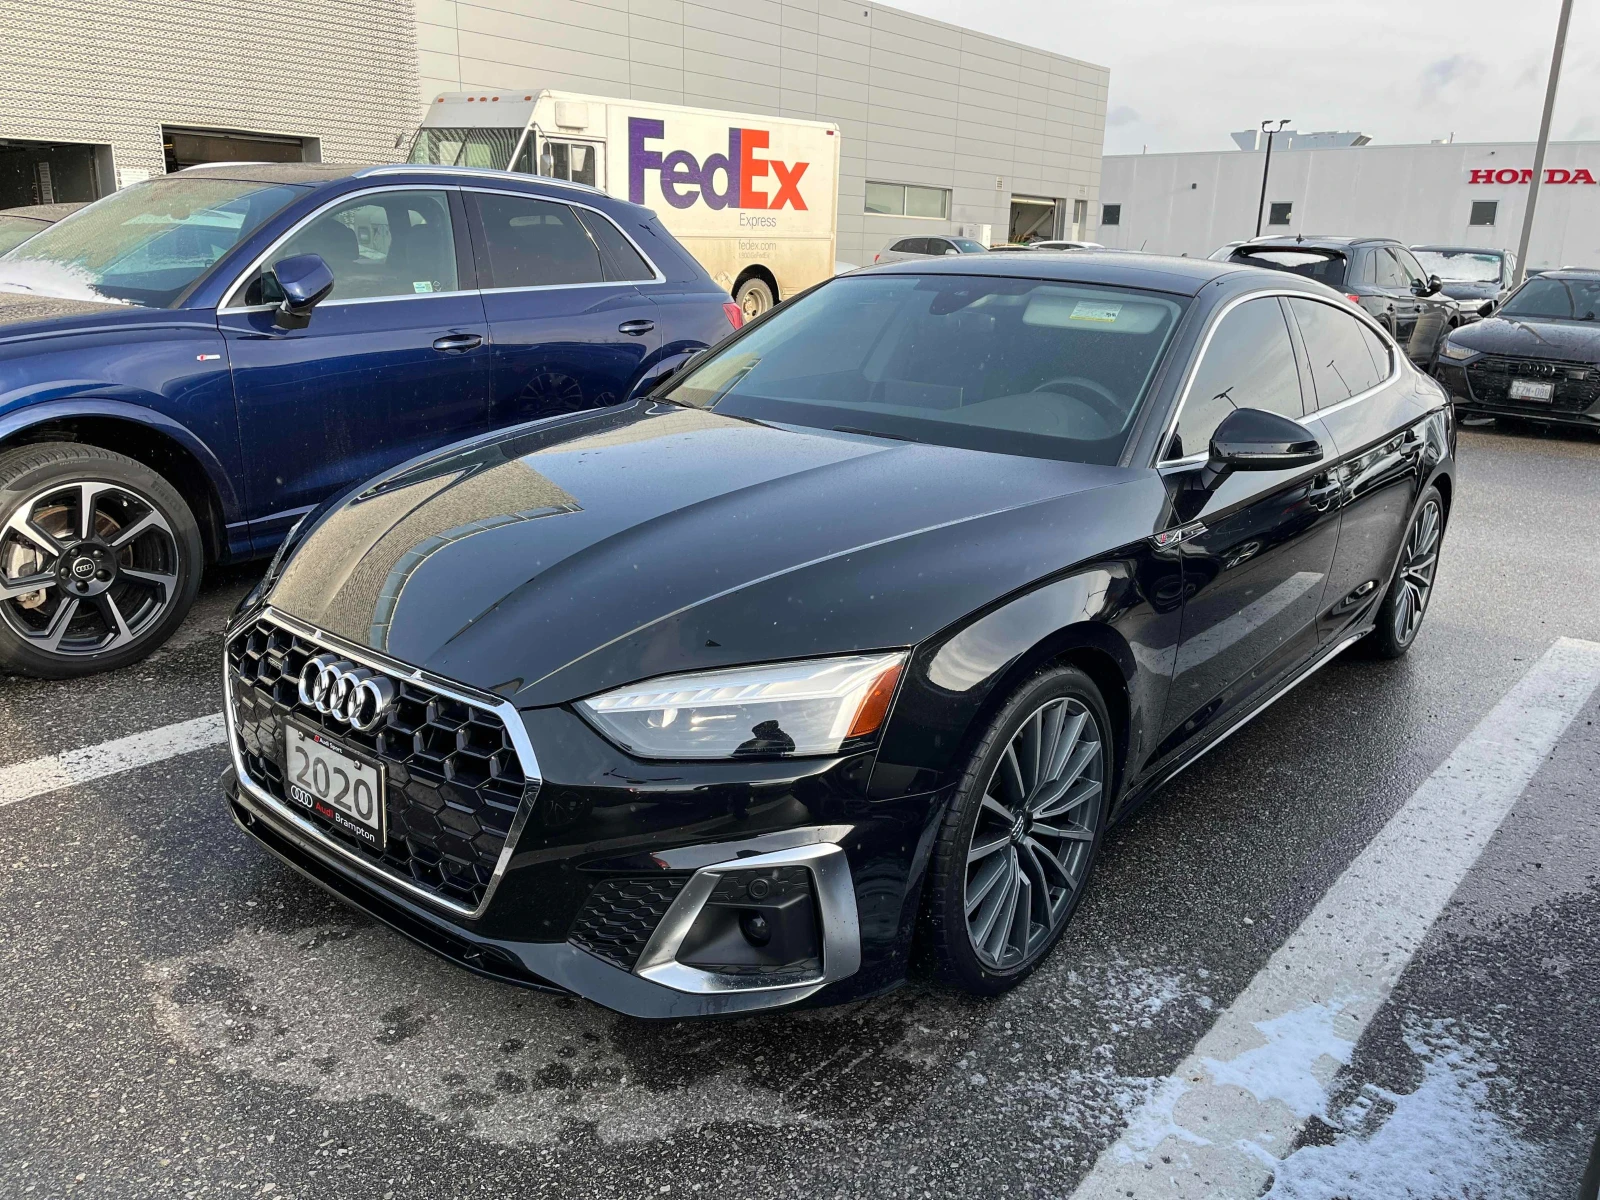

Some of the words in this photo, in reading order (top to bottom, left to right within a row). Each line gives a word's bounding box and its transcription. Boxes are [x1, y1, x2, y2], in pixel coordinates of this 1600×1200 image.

[628, 116, 810, 211] FedEx
[739, 212, 777, 229] Express
[738, 239, 777, 251] fedex.com
[295, 745, 374, 821] 2020
[315, 802, 334, 819] Audi
[335, 812, 375, 842] Brampton
